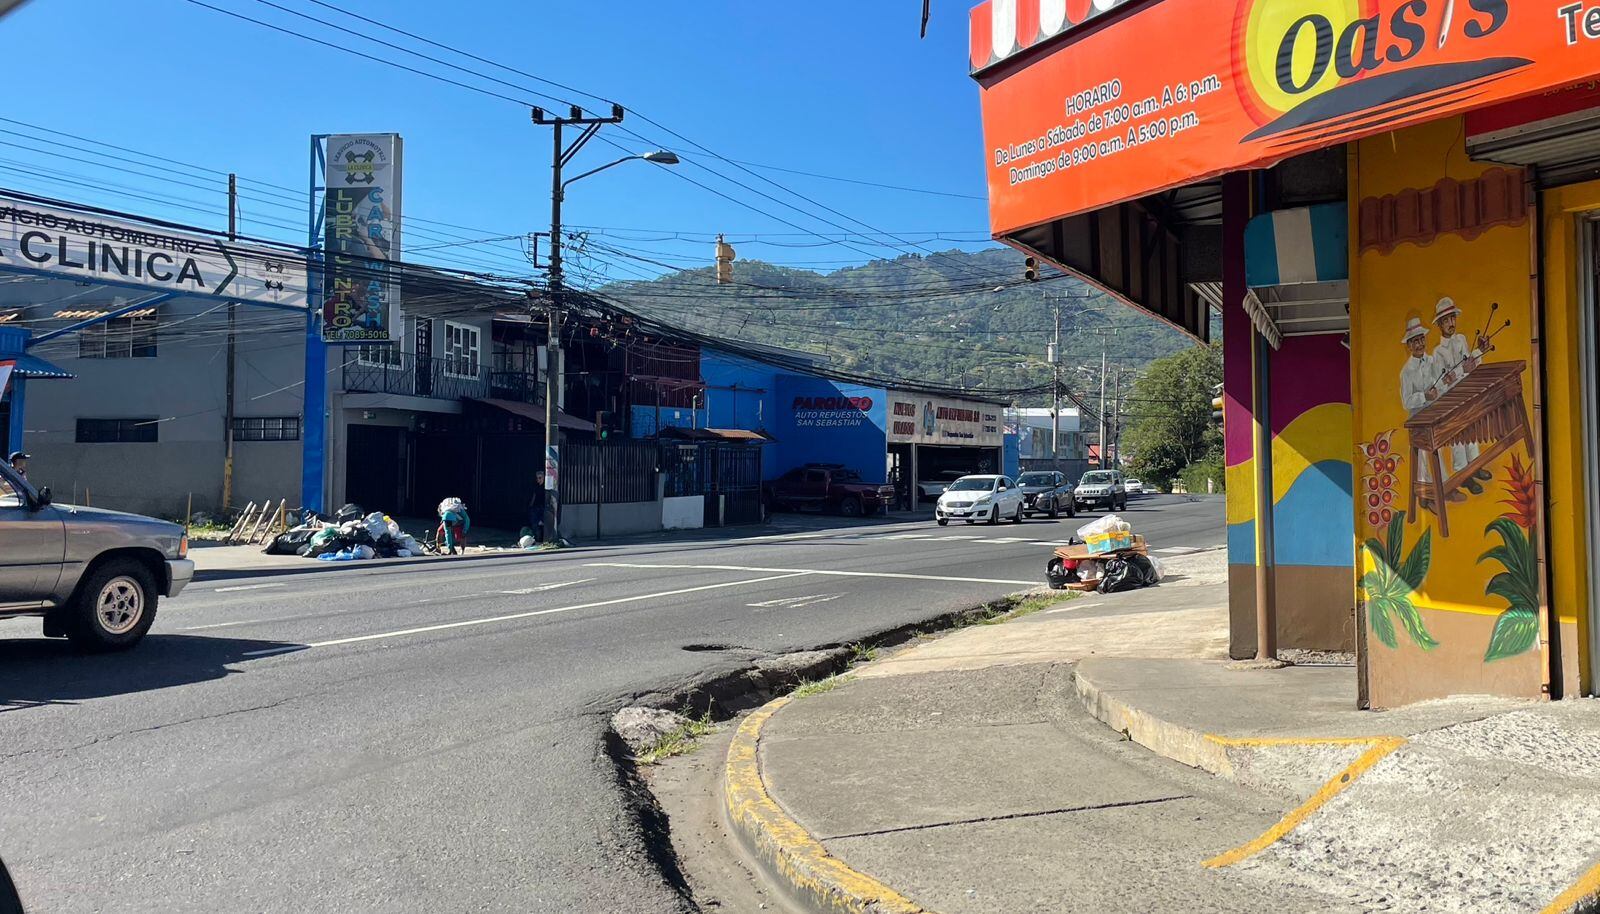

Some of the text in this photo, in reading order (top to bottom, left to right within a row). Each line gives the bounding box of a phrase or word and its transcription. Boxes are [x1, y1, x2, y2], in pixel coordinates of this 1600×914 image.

[995, 73, 1222, 167] De Lunes a Sábado de 7:00 a.m. A 6: p.m.
[1066, 80, 1121, 116] HORARIO
[1010, 111, 1200, 185] Domingos de 9:00 a.m. A 5:00 p.m.
[20, 230, 205, 287] CLINICA
[364, 186, 384, 328] CAR WASH
[344, 329, 388, 340] 7089-5016
[795, 411, 868, 420] AUTO REPUESTOS
[796, 419, 862, 427] SAN SEBASTIAN
